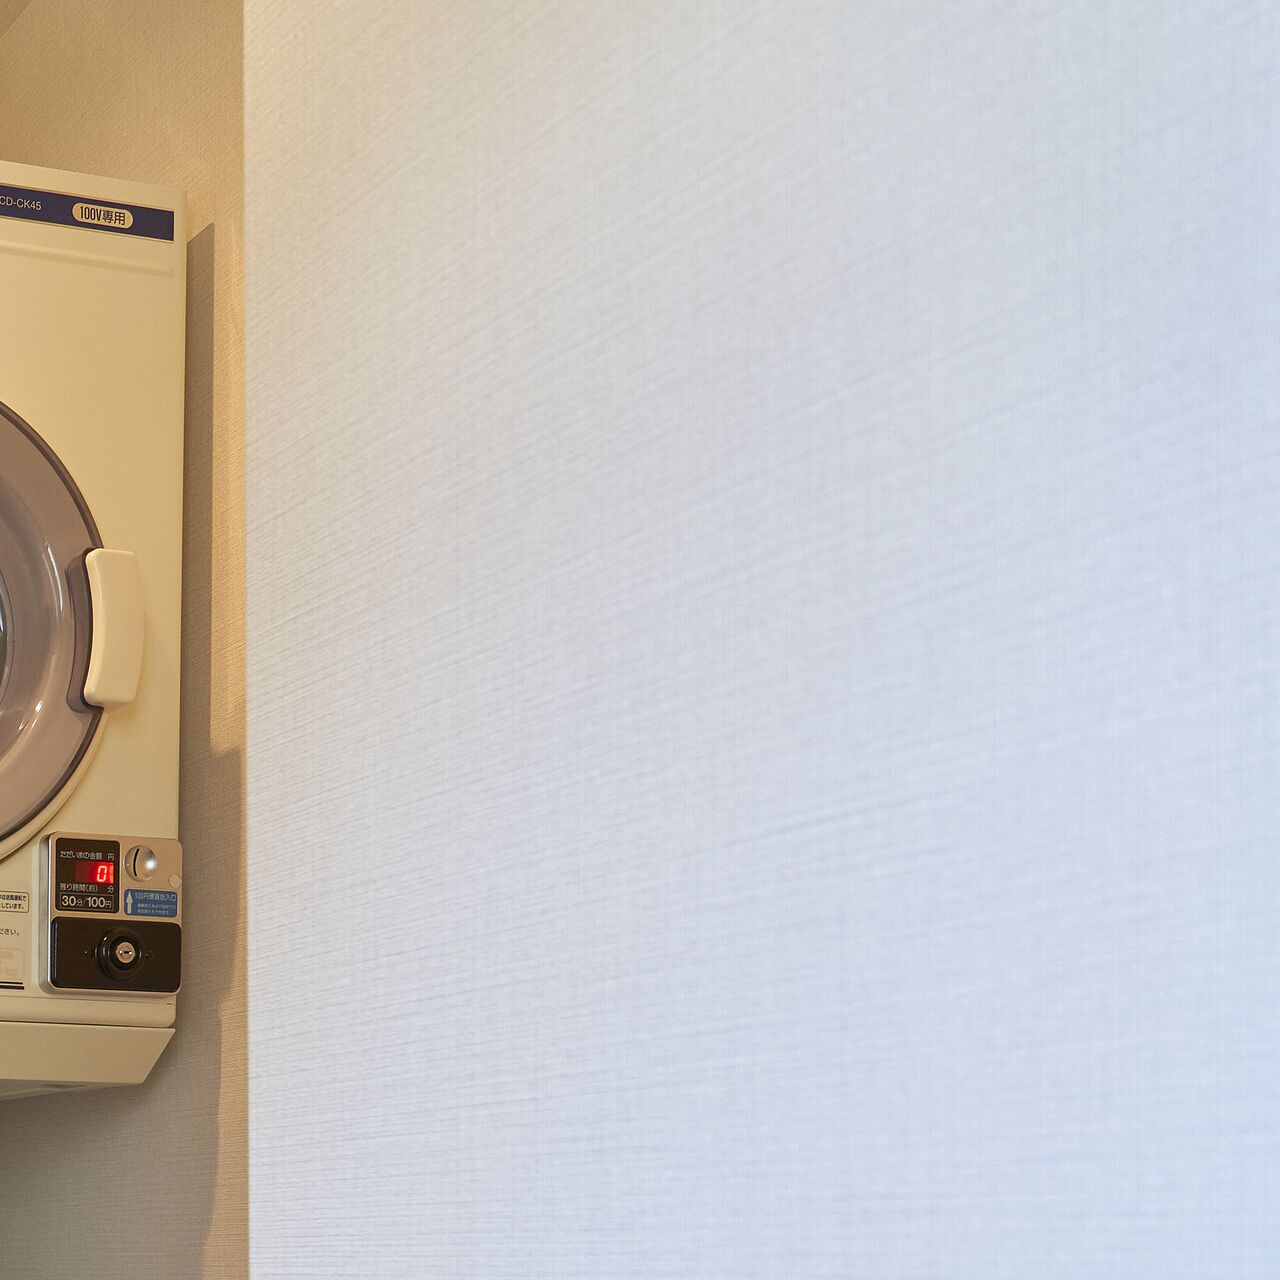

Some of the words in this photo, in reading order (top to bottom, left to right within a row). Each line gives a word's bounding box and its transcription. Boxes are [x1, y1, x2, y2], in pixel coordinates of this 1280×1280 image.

[78, 205, 127, 226] 100V専用
[108, 853, 115, 861] 円
[96, 865, 107, 882] 0
[107, 885, 114, 894] 分
[61, 895, 112, 908] 30分/100円
